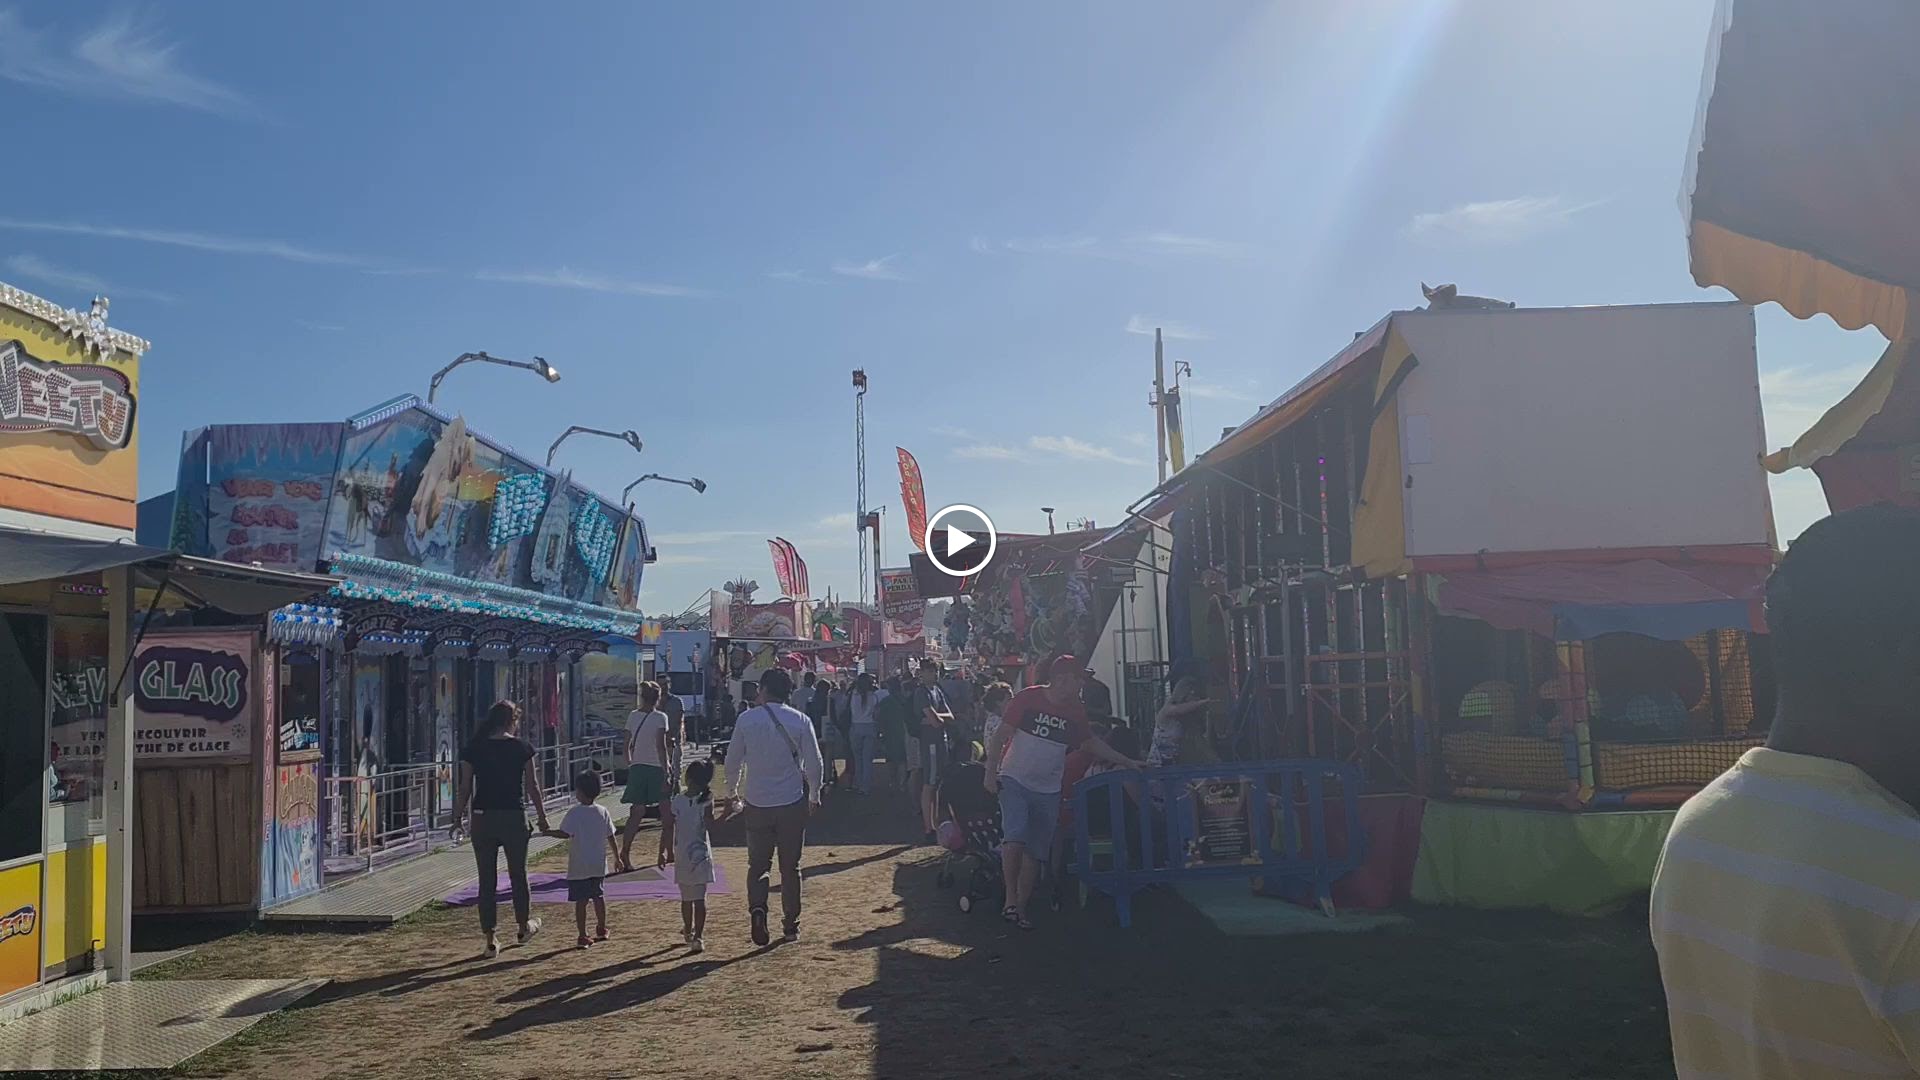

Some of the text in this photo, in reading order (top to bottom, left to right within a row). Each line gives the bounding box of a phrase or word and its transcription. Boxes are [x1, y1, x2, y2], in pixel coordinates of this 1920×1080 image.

[355, 616, 398, 637] SORTIE
[139, 659, 241, 710] GLASS
[1034, 712, 1068, 730] JACK
[133, 727, 208, 741] ECOUVRIR
[1032, 724, 1050, 737] JO
[166, 741, 185, 753] DE
[188, 740, 231, 752] GLACE
